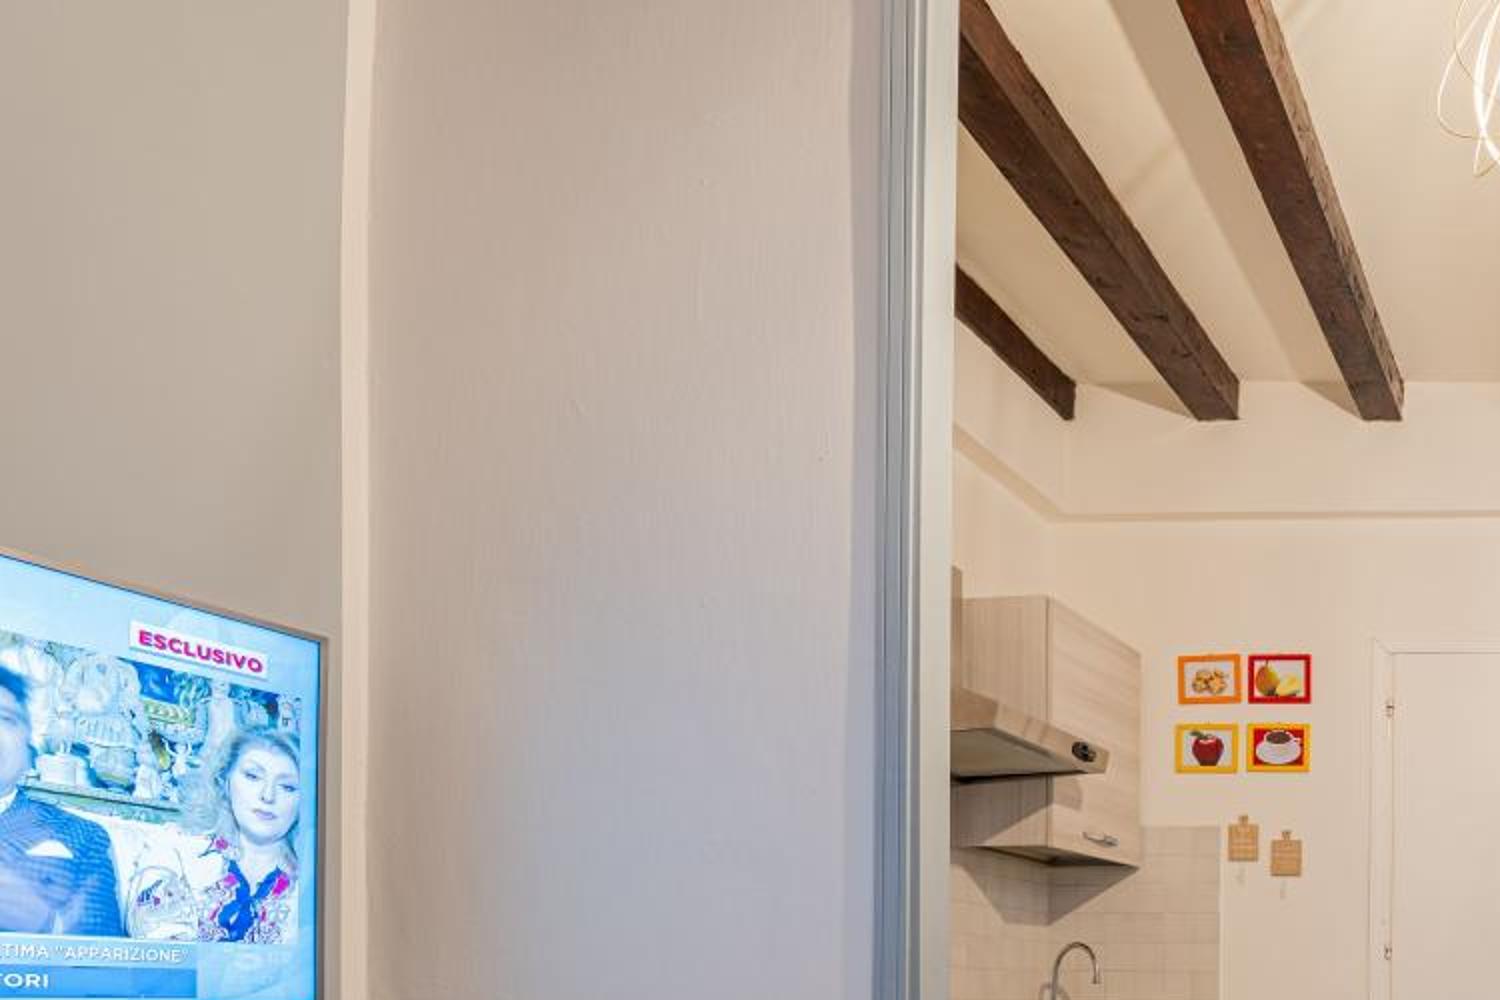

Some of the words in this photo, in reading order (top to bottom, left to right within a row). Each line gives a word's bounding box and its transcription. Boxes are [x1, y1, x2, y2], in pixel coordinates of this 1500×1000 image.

[138, 629, 263, 673] ESCLUSIVO
[0, 943, 49, 959] TIMA
[0, 973, 49, 988] ORI
